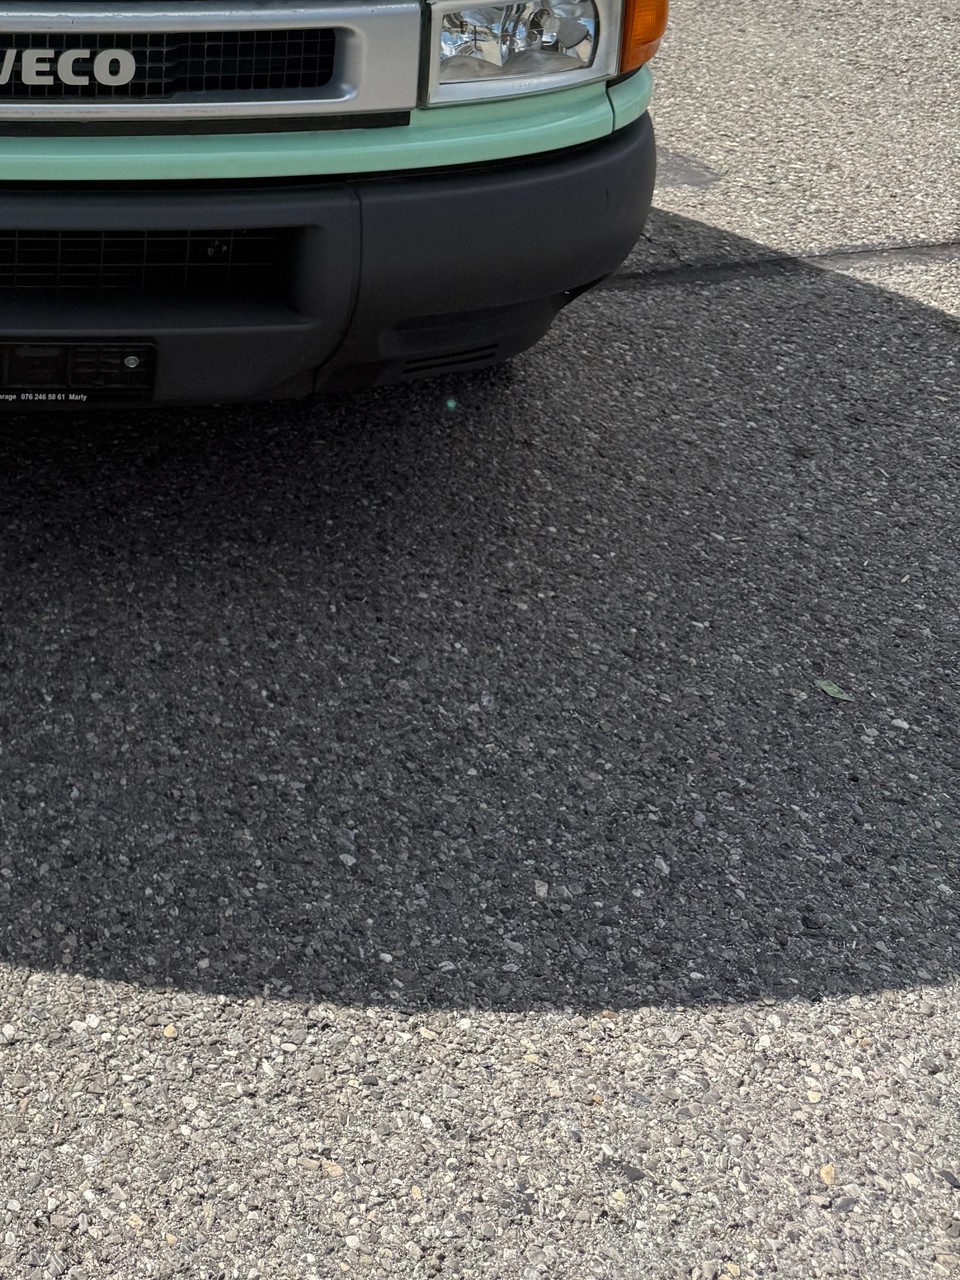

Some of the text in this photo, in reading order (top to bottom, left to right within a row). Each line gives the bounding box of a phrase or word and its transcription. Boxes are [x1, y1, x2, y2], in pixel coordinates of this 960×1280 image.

[20, 393, 33, 401] 076
[34, 393, 47, 401] 246
[47, 393, 57, 401] 58
[57, 393, 66, 401] 61
[68, 393, 88, 402] Marly
